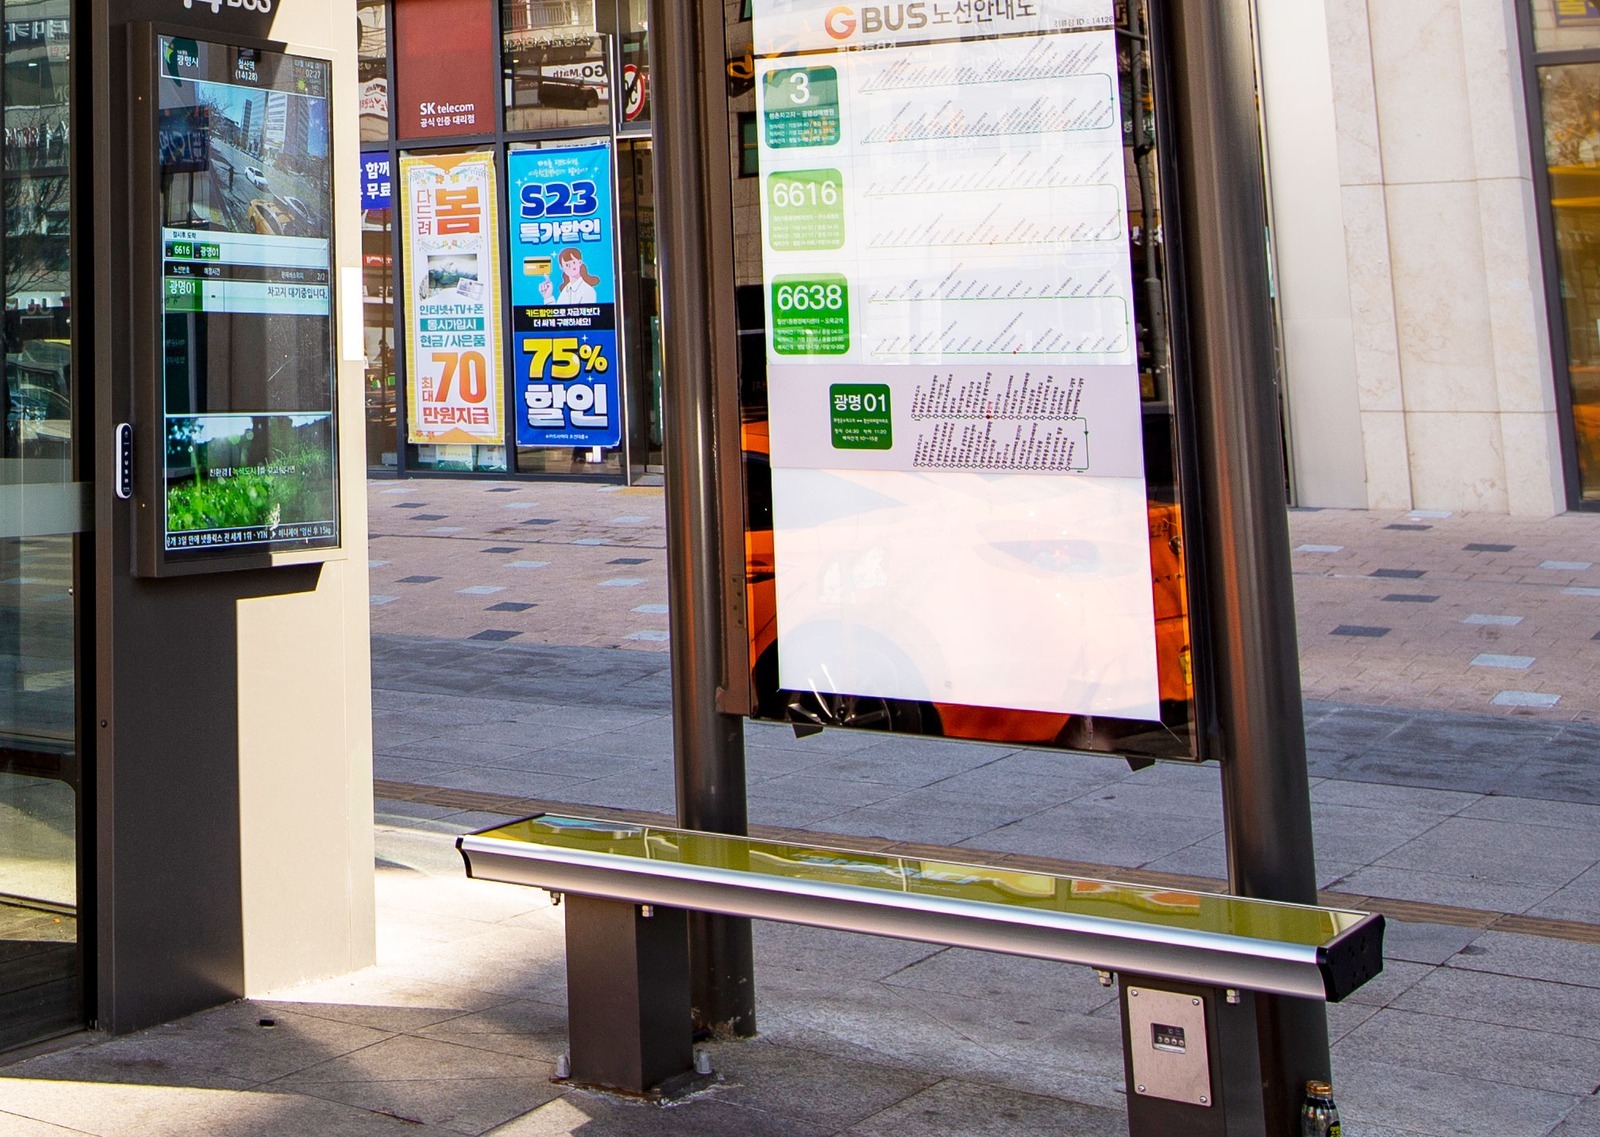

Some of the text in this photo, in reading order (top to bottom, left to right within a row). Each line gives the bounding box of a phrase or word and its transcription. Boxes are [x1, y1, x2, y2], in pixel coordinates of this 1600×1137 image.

[1076, 18, 1085, 26] ID
[1091, 16, 1114, 25] 14128
[177, 54, 199, 68] 광명시
[237, 59, 255, 71] 철산역
[235, 71, 258, 82] (14128)
[789, 72, 810, 104] 3
[420, 102, 474, 116] SK telecom
[420, 114, 475, 128] 공식 인증 대리점
[366, 182, 391, 200] 무료
[773, 180, 838, 208] 6616
[520, 179, 599, 219] S23
[435, 186, 481, 235] 봄
[520, 219, 601, 243] 특가할인
[174, 245, 191, 255] 6616
[200, 246, 219, 258] 광명01
[316, 272, 326, 281] 2/2
[169, 279, 196, 296] 광명01
[267, 286, 328, 300] 차고지 대기중입니다.
[777, 284, 842, 311] 6638
[533, 318, 592, 328] 더 싸게 구매하세요!
[523, 337, 608, 379] 75%
[432, 351, 487, 404] 70
[524, 383, 609, 428] 할인
[423, 406, 490, 425] 만원지급
[201, 535, 222, 545] 넷플릭스
[257, 531, 268, 540] YTN
